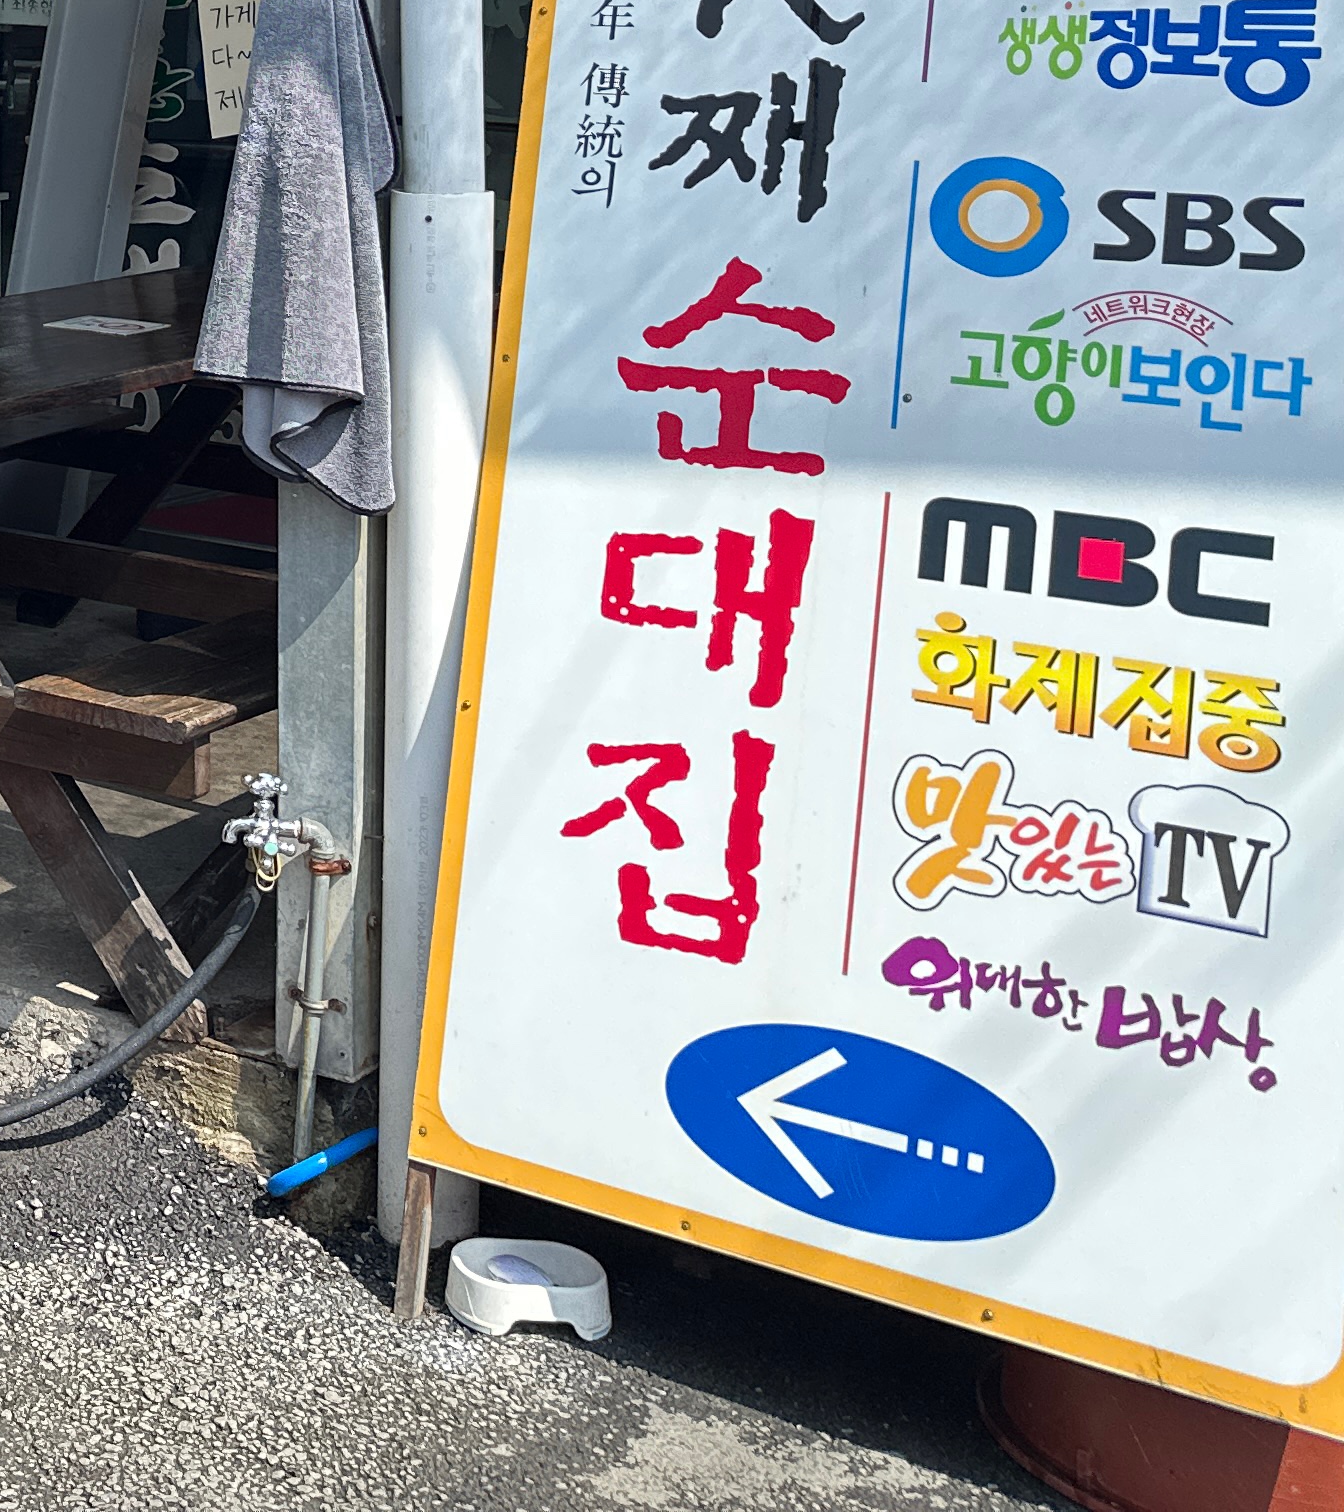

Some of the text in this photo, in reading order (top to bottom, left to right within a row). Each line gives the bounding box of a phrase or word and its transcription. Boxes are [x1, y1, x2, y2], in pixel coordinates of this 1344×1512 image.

[209, 0, 257, 29] 가게
[1092, 189, 1306, 272] SBS
[560, 256, 852, 964] 순대집
[917, 496, 1275, 627] MBC
[912, 611, 1287, 773] 화제집중
[904, 761, 1271, 920] 맛있는 TV
[882, 935, 1277, 1092] 위대한 밥상
